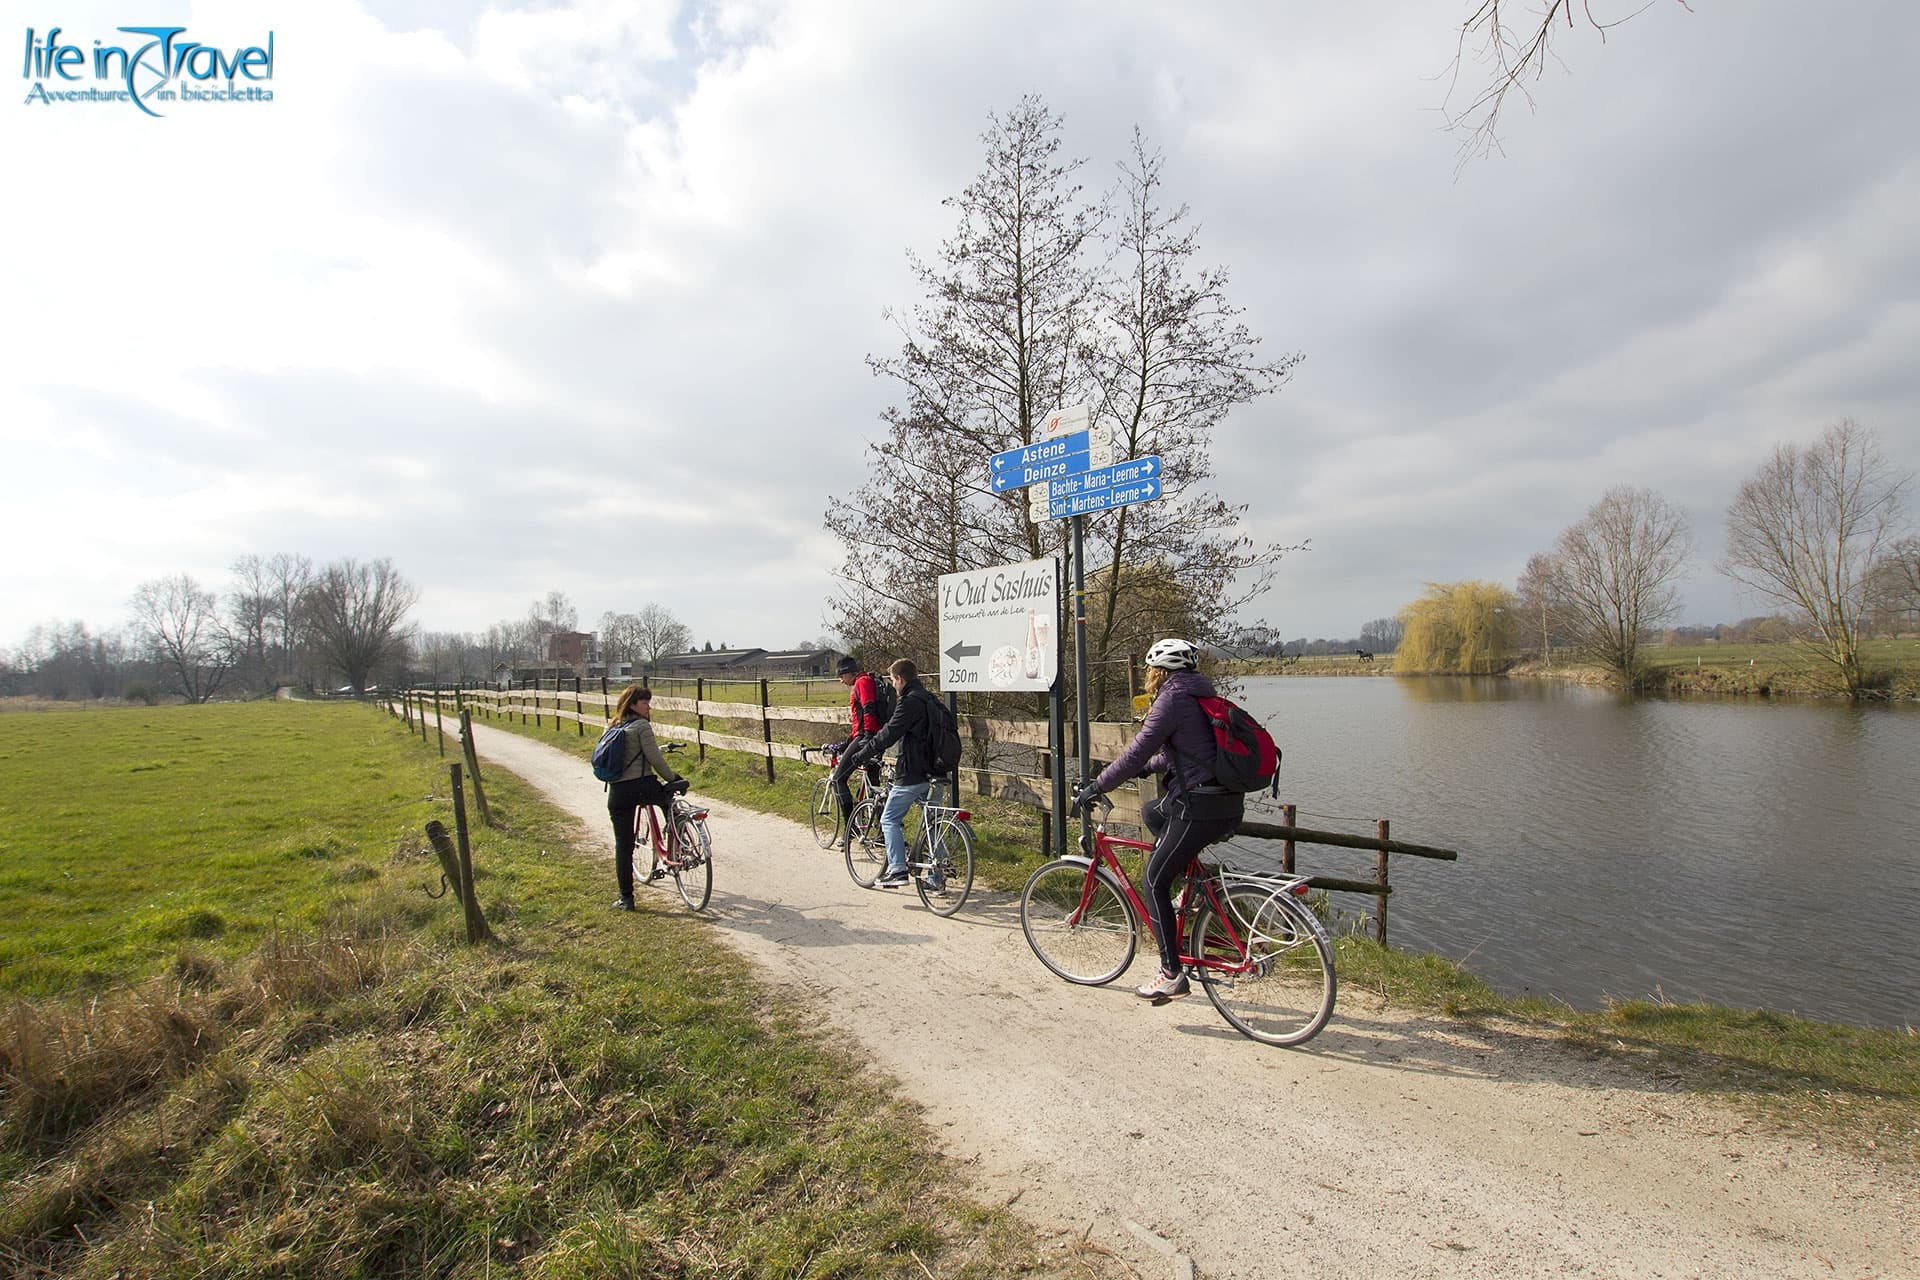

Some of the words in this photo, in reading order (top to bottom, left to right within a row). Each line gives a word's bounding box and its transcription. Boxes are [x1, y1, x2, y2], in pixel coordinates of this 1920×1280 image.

[1022, 443, 1066, 463] Astene
[1024, 461, 1066, 482] Deinze
[1051, 487, 1139, 516] Sint-Martens-Leerne
[955, 576, 989, 607] Oud
[991, 569, 1052, 603] Sashuis
